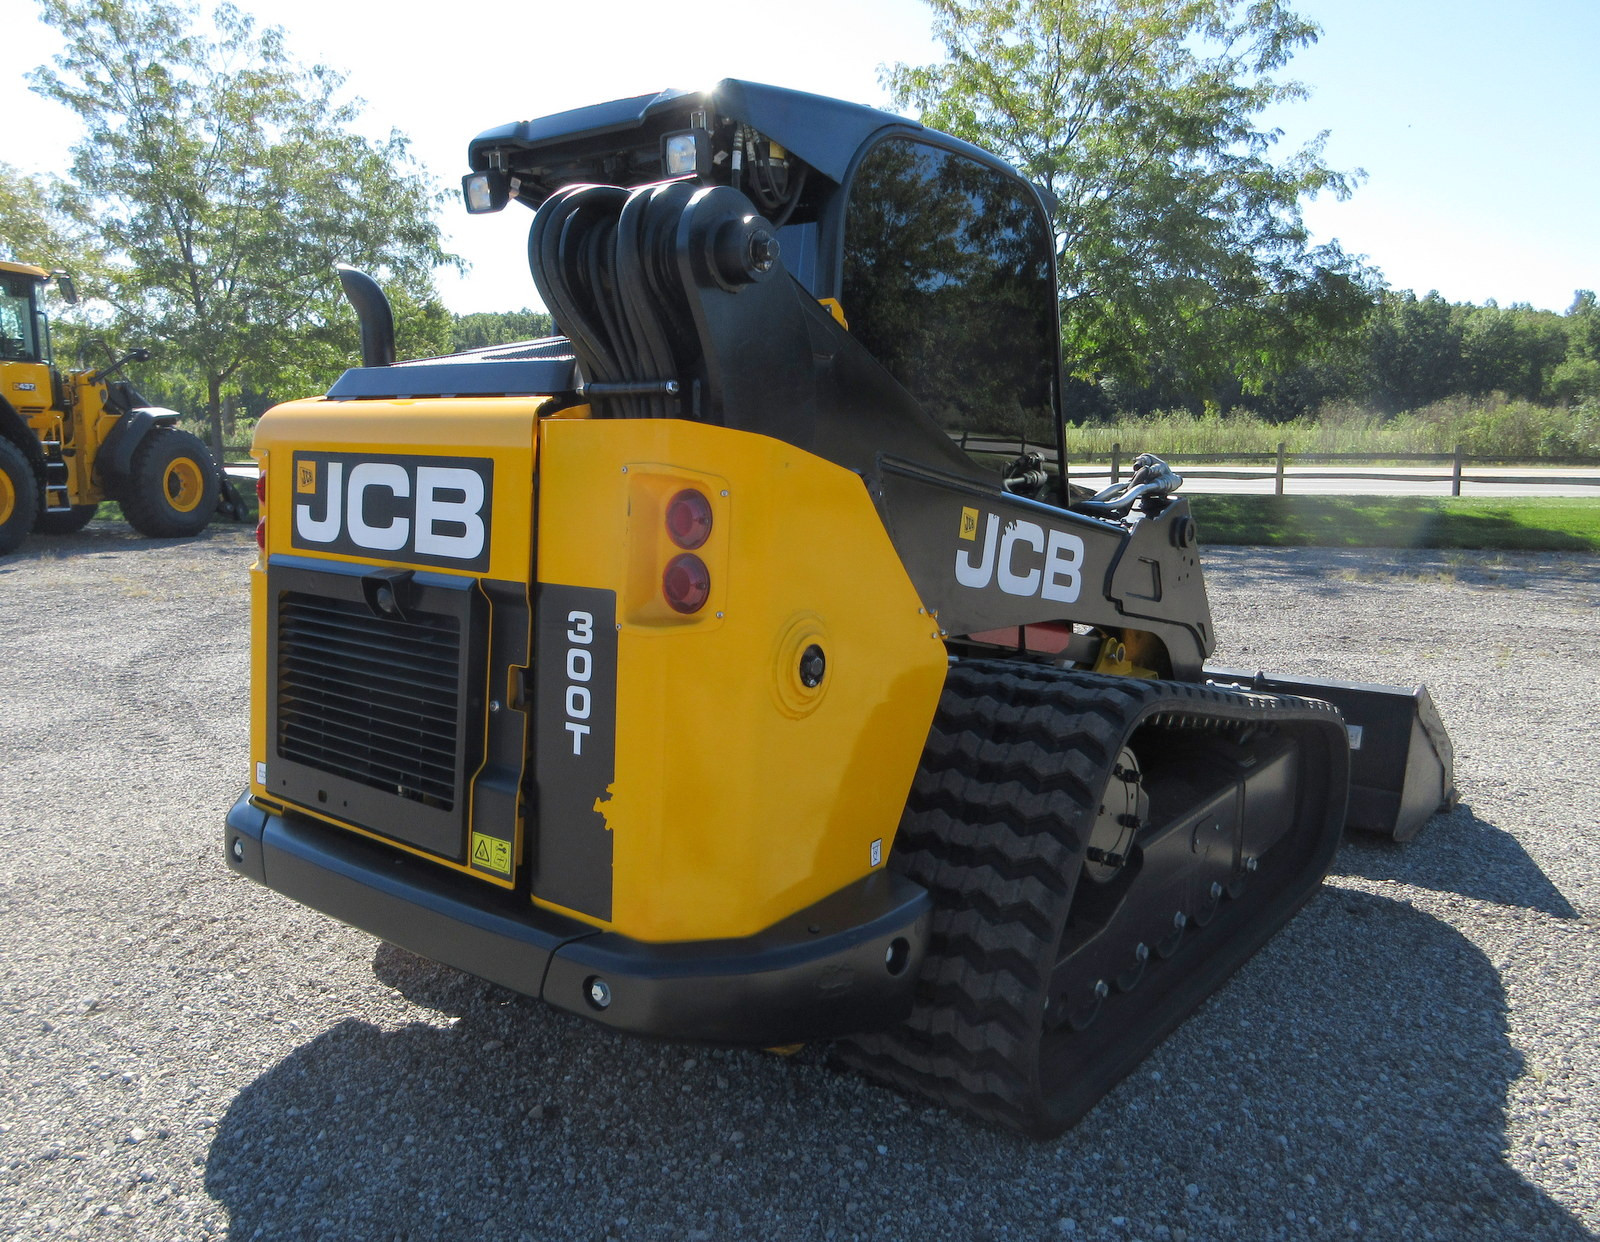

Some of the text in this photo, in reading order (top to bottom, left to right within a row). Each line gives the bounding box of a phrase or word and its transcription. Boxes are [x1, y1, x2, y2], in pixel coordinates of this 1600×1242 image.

[296, 462, 485, 560] JCB
[954, 512, 1084, 604] JCB
[565, 610, 593, 756] 300T
